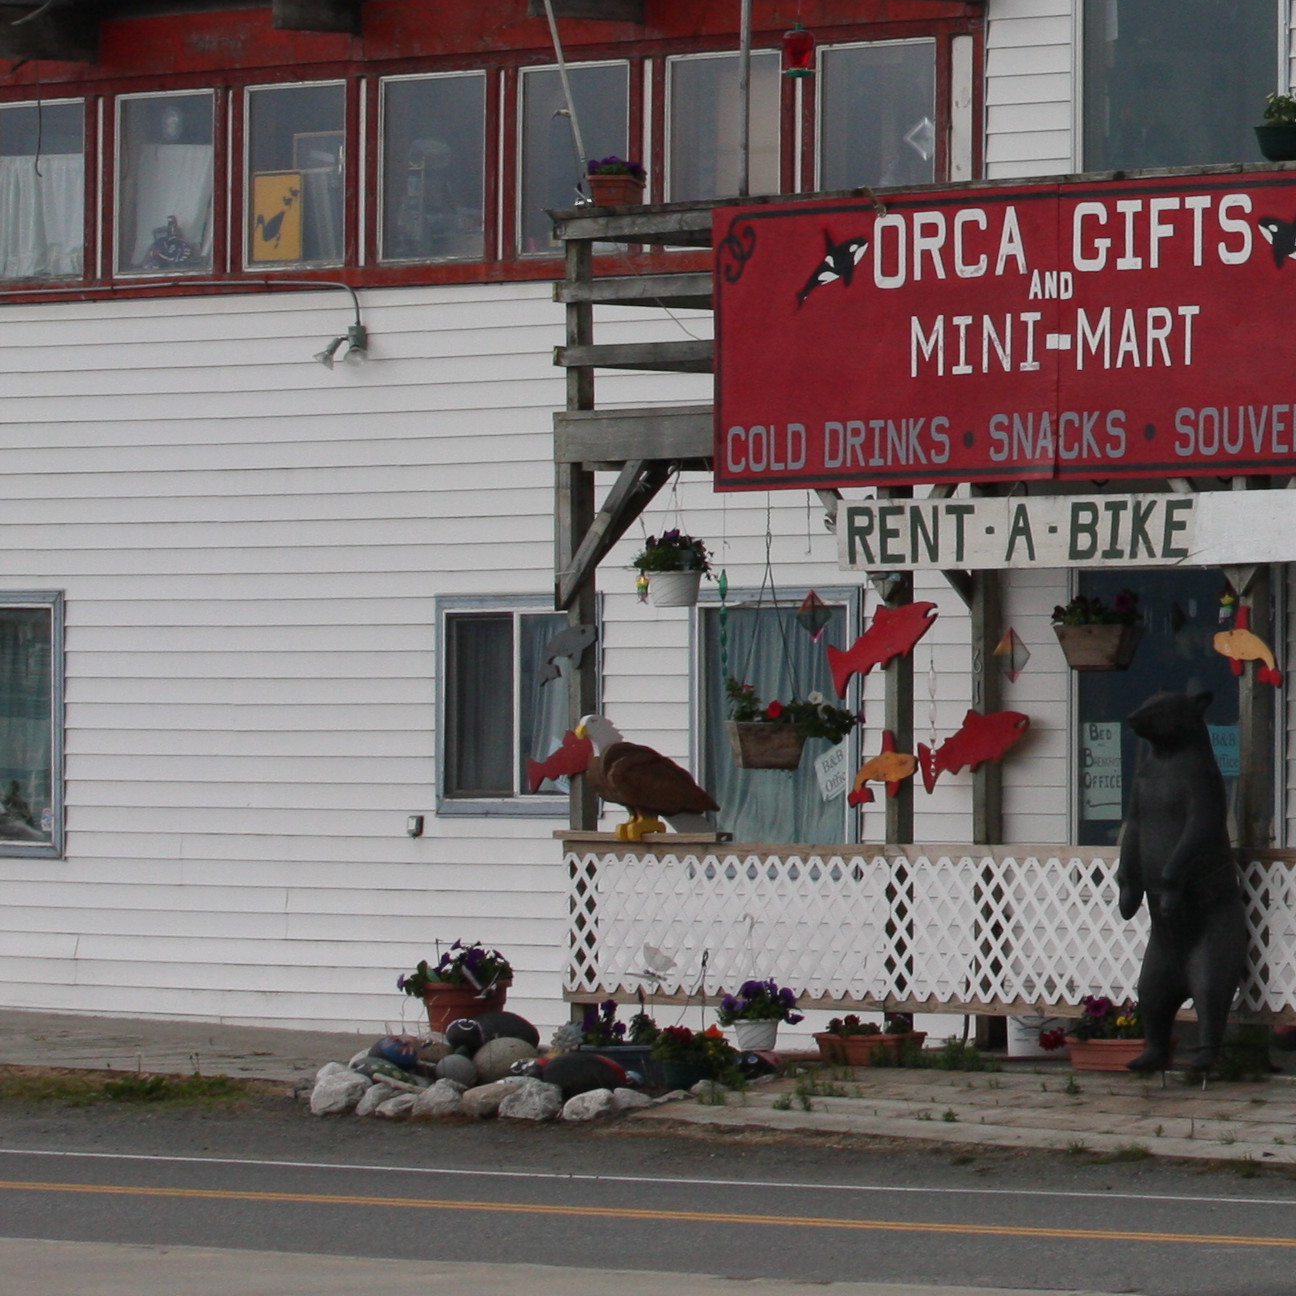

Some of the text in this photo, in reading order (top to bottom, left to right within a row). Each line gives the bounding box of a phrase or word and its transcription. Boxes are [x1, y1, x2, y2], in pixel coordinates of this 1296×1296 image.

[873, 193, 1253, 289] ORCA GIFTS
[1029, 268, 1073, 301] AND
[911, 305, 1201, 378] MINI-MART
[727, 421, 806, 473] COLD
[824, 415, 951, 468] DRINKS
[989, 409, 1127, 462] SNACKS
[821, 749, 843, 773] B&B
